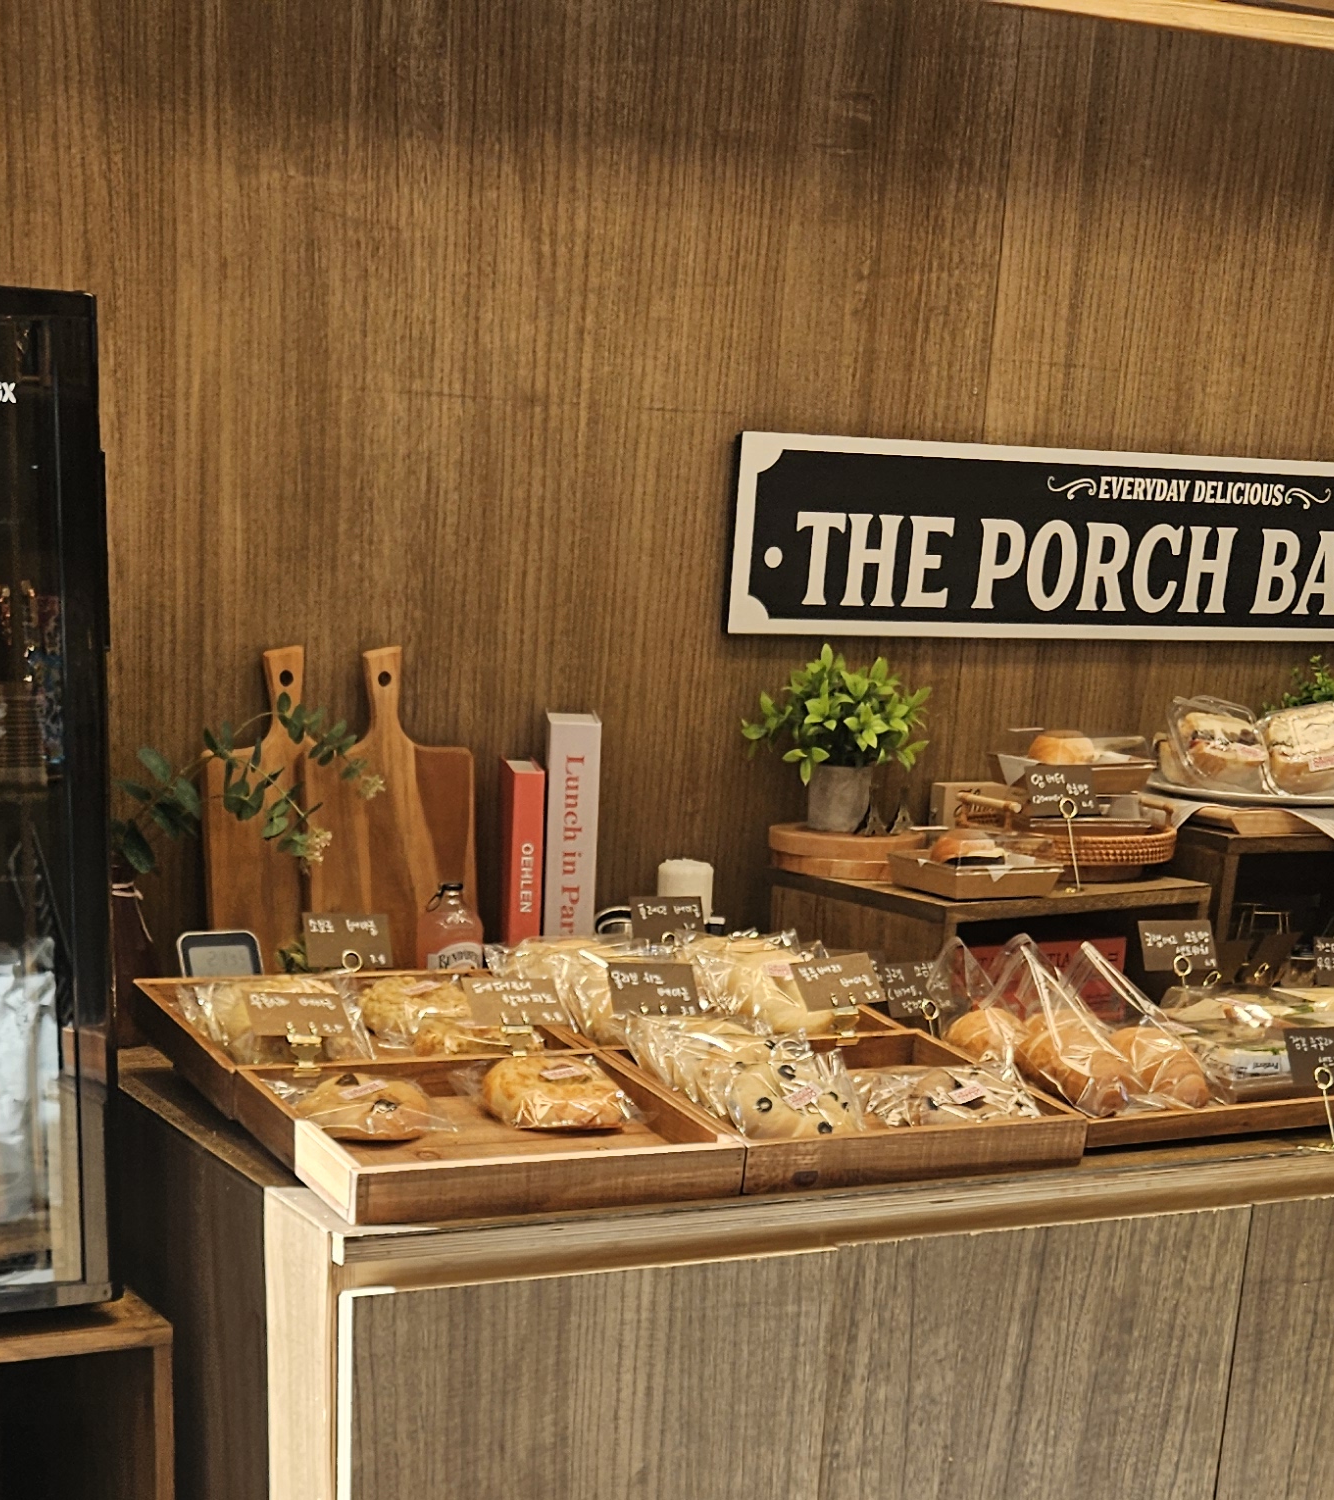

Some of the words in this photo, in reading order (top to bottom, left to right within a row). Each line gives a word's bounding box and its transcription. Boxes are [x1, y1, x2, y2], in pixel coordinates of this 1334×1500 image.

[1098, 475, 1188, 505] EVERYDAY
[1192, 479, 1285, 508] DELICIOUS
[796, 509, 955, 609] THE
[970, 516, 1238, 615] PORCH
[563, 755, 585, 841] Lunch
[519, 842, 535, 913] OEHLEN
[562, 851, 583, 876] in
[560, 885, 580, 935] Par
